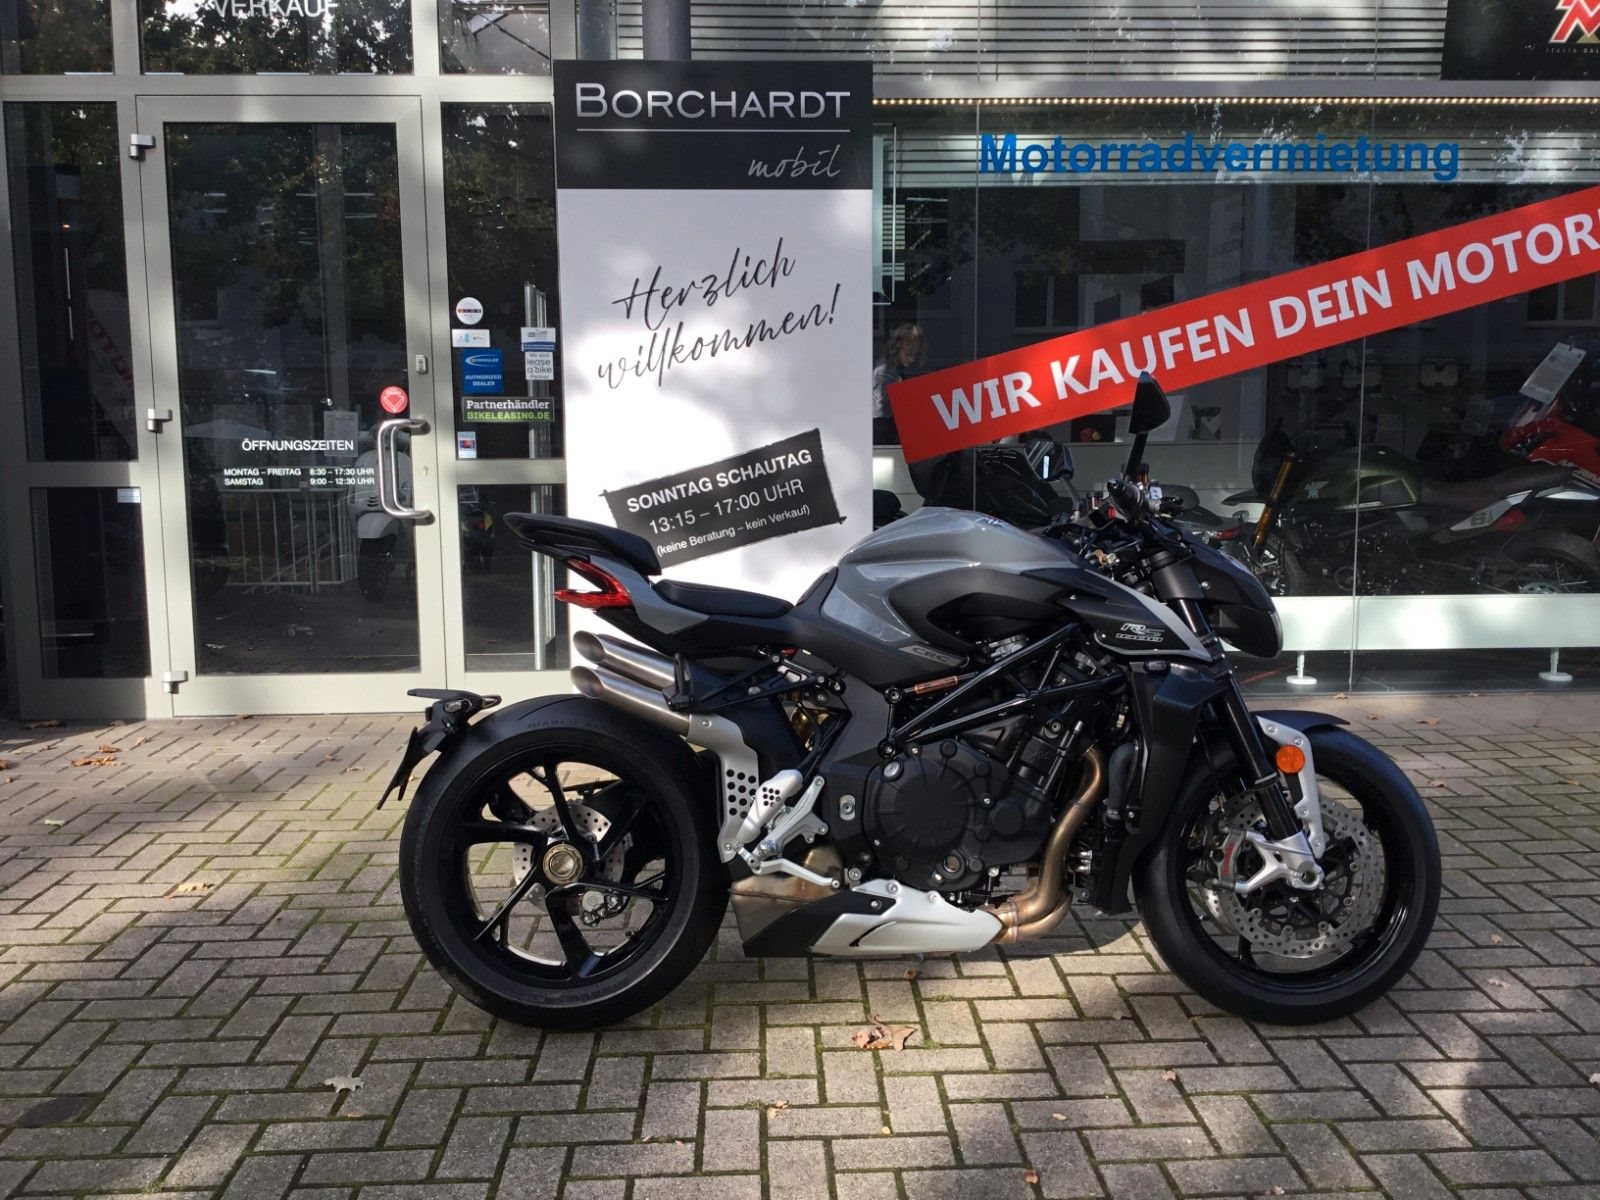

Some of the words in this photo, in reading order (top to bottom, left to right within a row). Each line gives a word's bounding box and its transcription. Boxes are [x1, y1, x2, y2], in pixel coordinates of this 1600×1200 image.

[747, 144, 841, 178] mobil
[979, 133, 1460, 182] Motorradvermietung
[611, 237, 796, 331] Herzlich
[597, 283, 841, 389] willkommen!
[930, 370, 1042, 431] WIR
[1050, 307, 1256, 400] KAUFEN
[1269, 268, 1393, 339] DEIN
[1406, 209, 1600, 300] MOTOR
[527, 358, 551, 366] lease
[466, 400, 550, 410] Partnerhändler
[467, 411, 550, 420] BIKELEASING.DE
[241, 438, 354, 451] ÖFFNUNGSZEITEN
[223, 468, 260, 476] MONTAG
[267, 468, 301, 476] FREITAG
[334, 468, 355, 476] 17:30
[357, 468, 375, 476] UHR
[224, 478, 264, 486] SAMSTAG
[626, 477, 713, 513] SONNTAG
[715, 449, 812, 487] SCHAUTAG
[649, 509, 696, 535] 13:15
[714, 491, 760, 517] 17:00
[764, 478, 805, 503] UHR
[656, 538, 688, 557] (keine
[689, 526, 736, 546] Beratung
[745, 517, 768, 531] kein
[768, 504, 811, 524] Verkauf)
